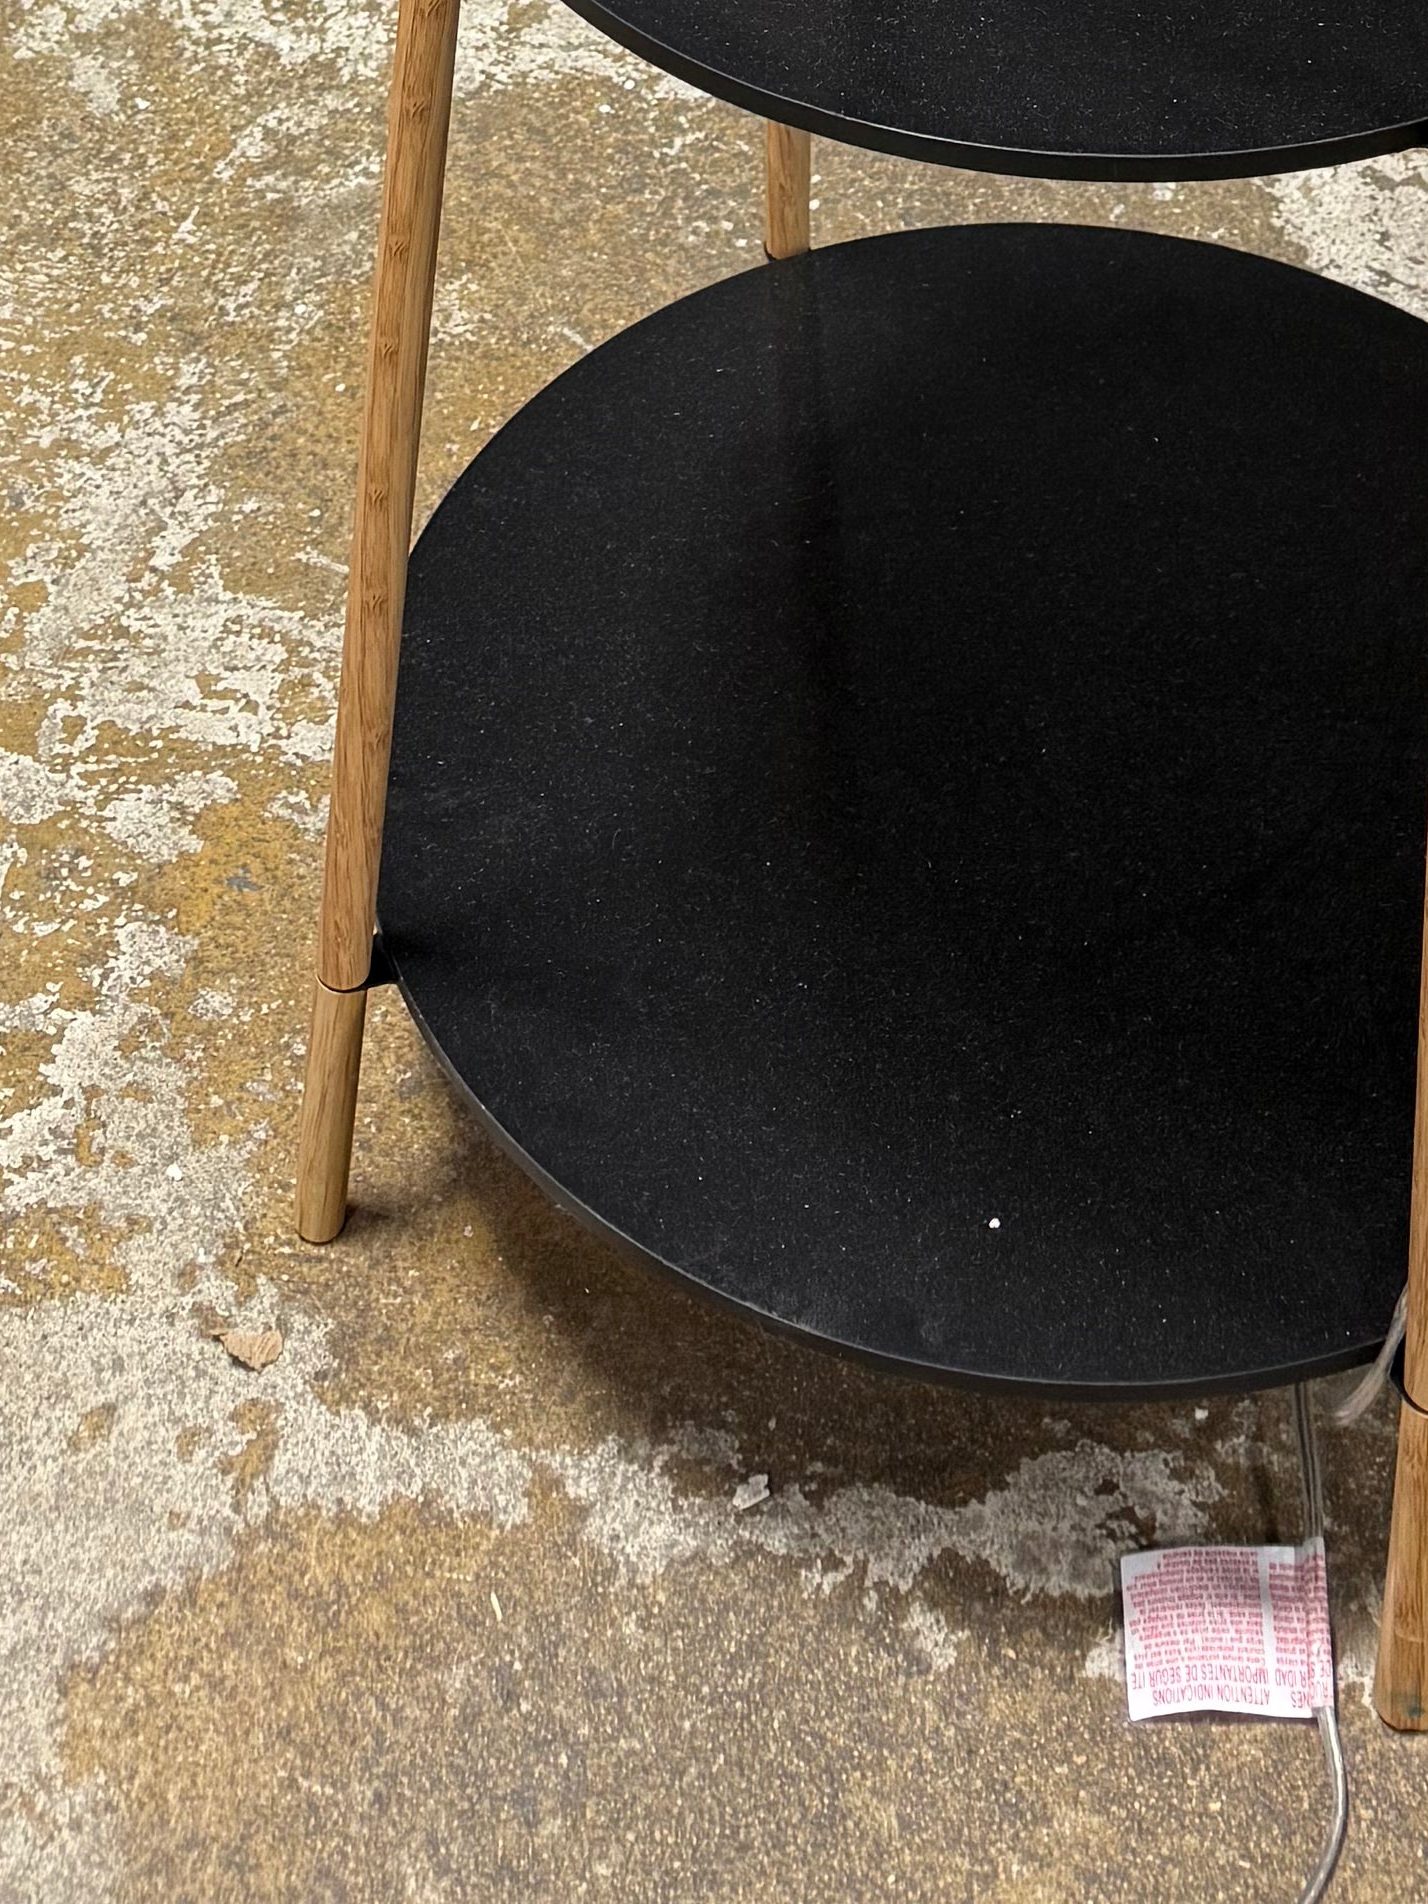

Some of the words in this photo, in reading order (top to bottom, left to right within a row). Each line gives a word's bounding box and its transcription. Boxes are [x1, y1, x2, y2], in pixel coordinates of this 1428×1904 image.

[1200, 1663, 1269, 1685] IMPORTANTES
[1152, 1683, 1213, 1707] INDICATIONS
[1216, 1683, 1270, 1706] ATTENTION
